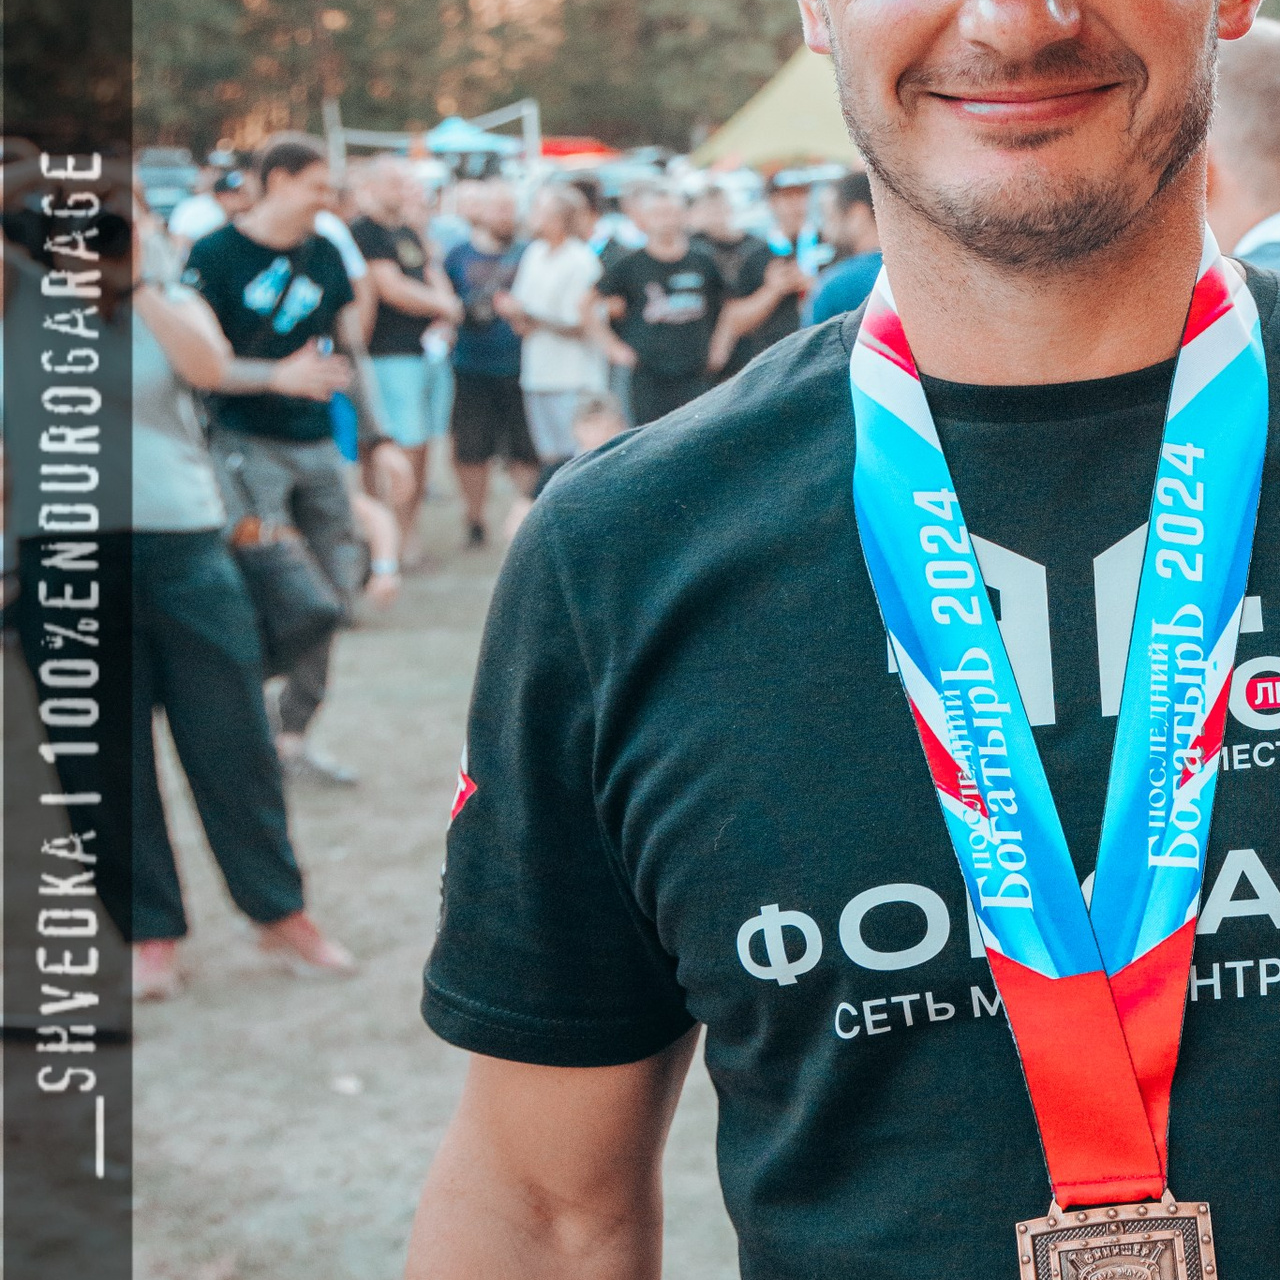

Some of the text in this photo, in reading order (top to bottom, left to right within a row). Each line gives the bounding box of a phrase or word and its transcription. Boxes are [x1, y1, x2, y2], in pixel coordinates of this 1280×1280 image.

[912, 486, 983, 627] 2024
[1155, 441, 1204, 584] 2024
[835, 992, 956, 1041] СЕТЬ
